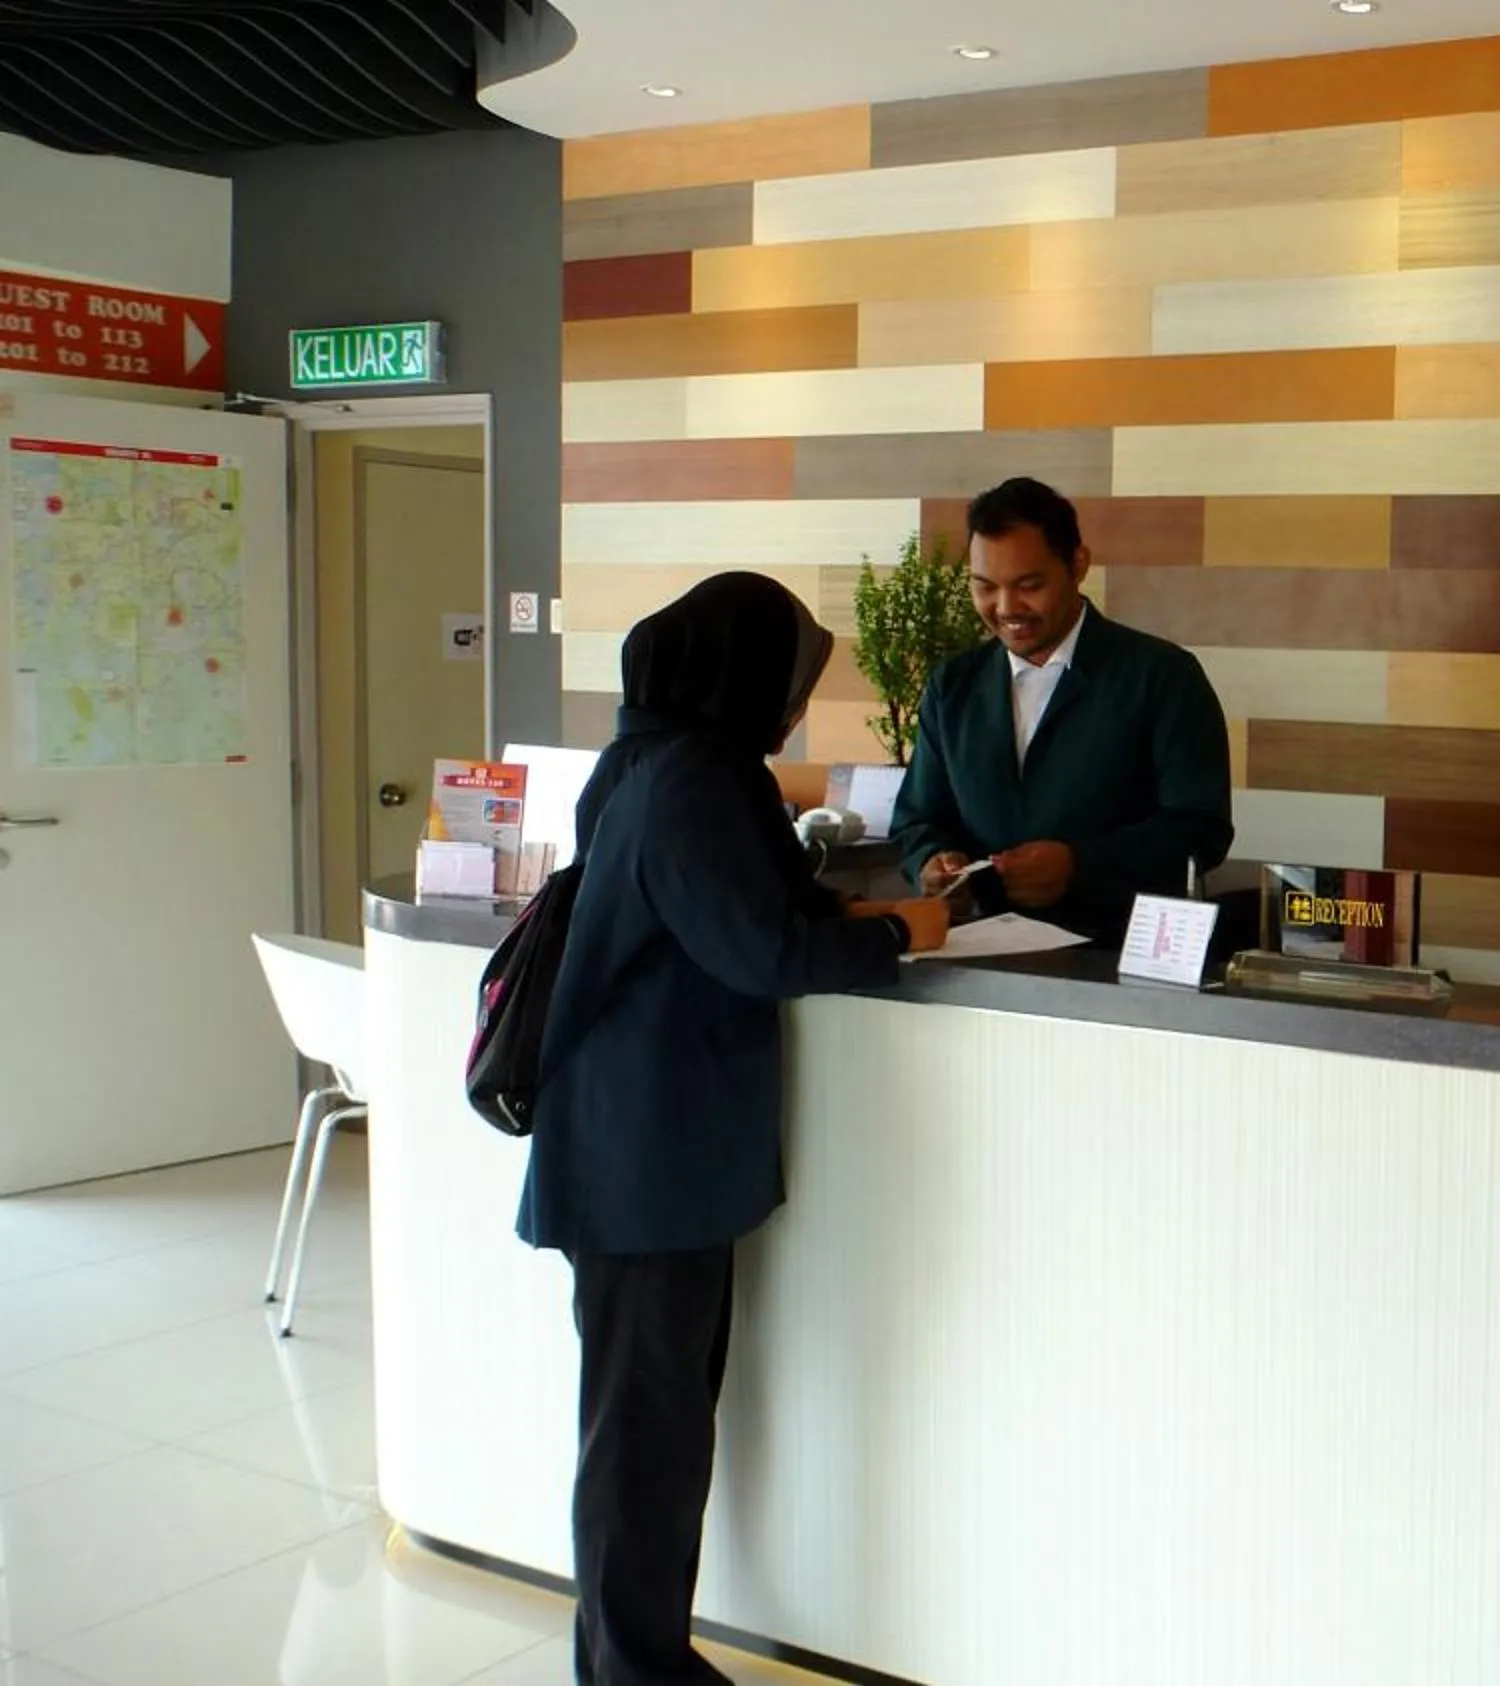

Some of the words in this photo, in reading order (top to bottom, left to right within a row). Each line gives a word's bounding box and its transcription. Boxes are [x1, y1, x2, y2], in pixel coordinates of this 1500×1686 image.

[86, 294, 166, 325] ROOM
[53, 320, 82, 339] to
[100, 327, 143, 348] 113
[57, 347, 87, 366] to
[102, 353, 150, 374] 212
[297, 331, 397, 379] KELUAR
[1314, 897, 1385, 928] RECEPTION
